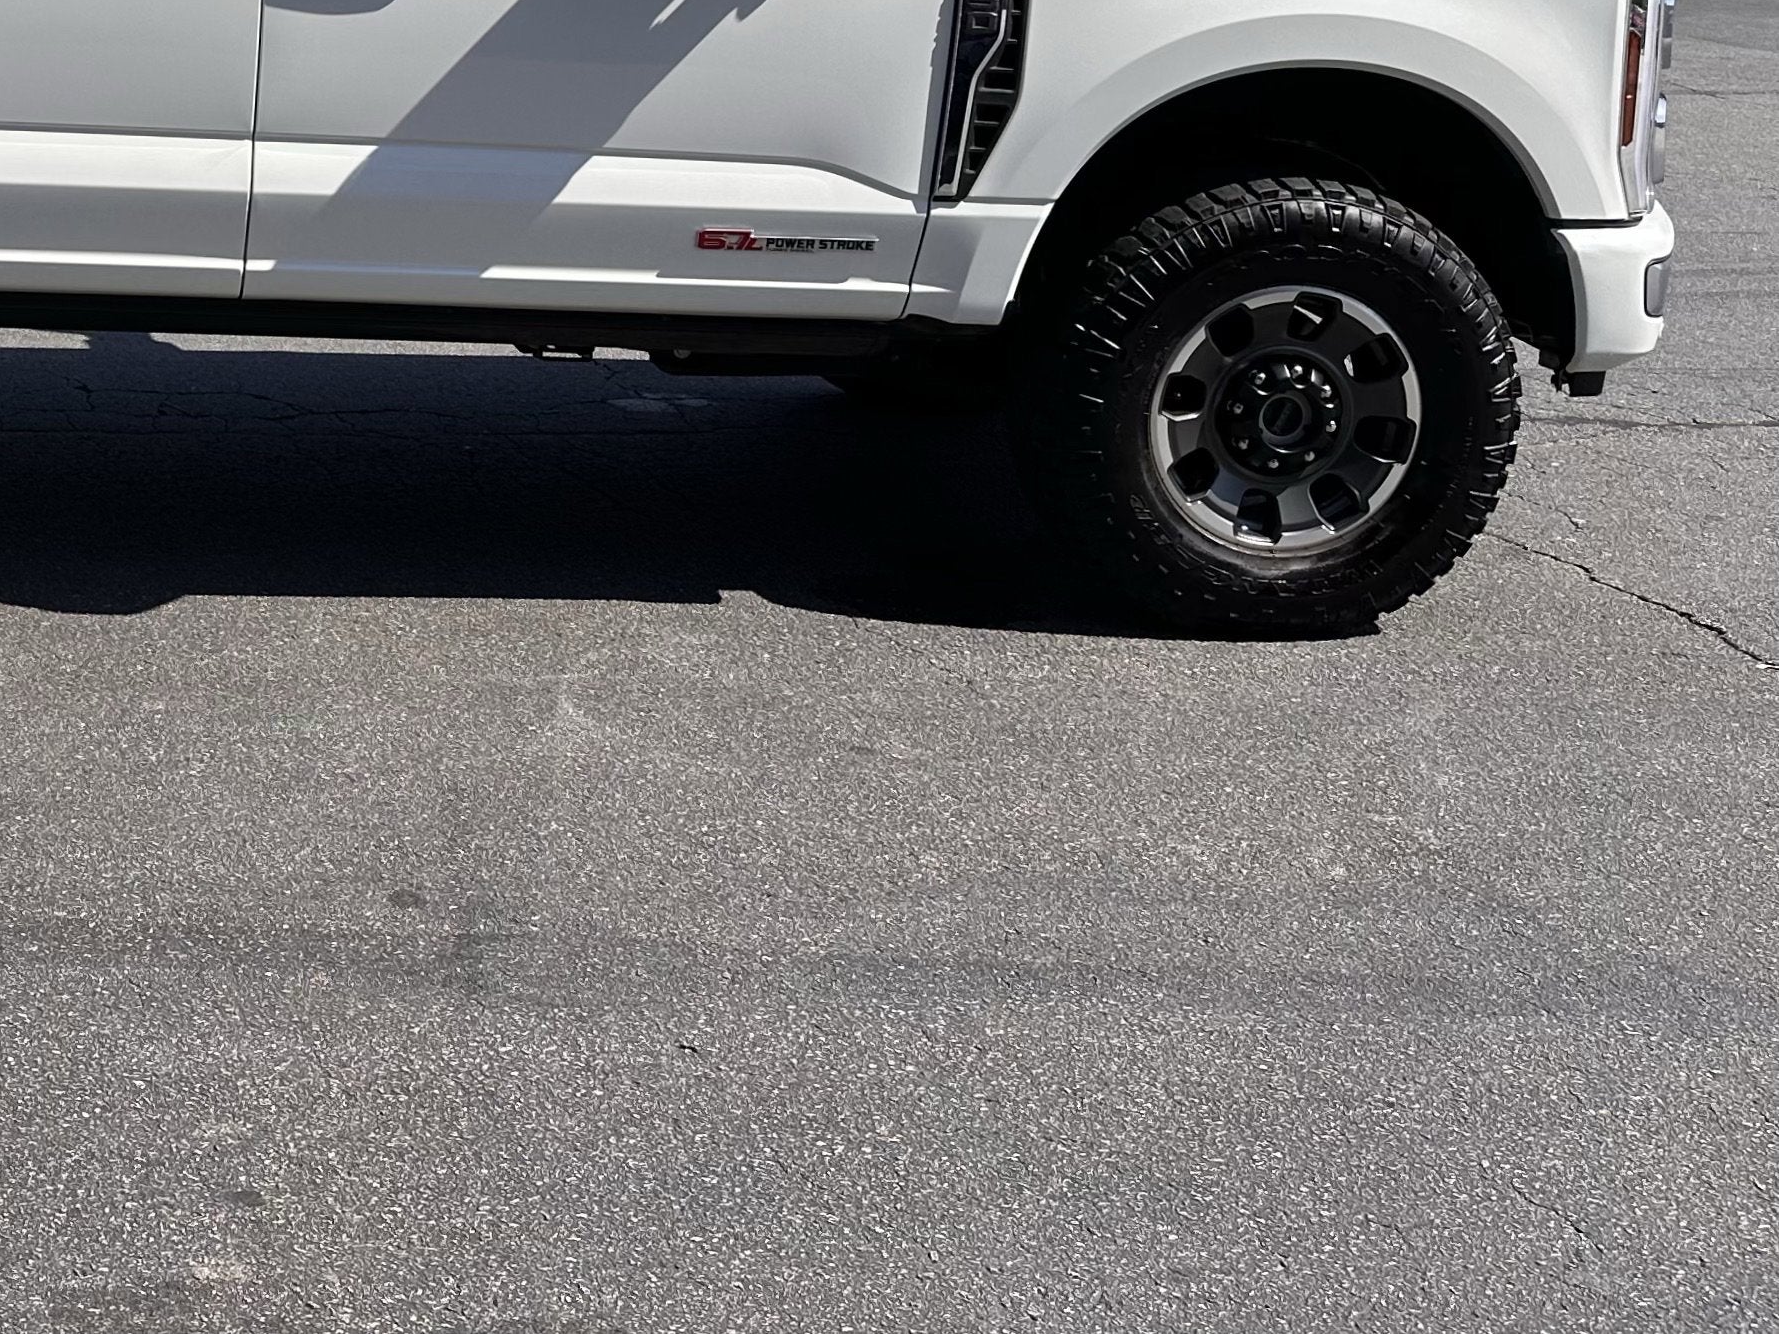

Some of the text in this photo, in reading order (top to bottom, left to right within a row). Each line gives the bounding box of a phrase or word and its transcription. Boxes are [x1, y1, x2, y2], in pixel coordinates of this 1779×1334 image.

[697, 227, 763, 251] 6.7L
[766, 237, 816, 249] POWER
[818, 239, 876, 251] STROKE
